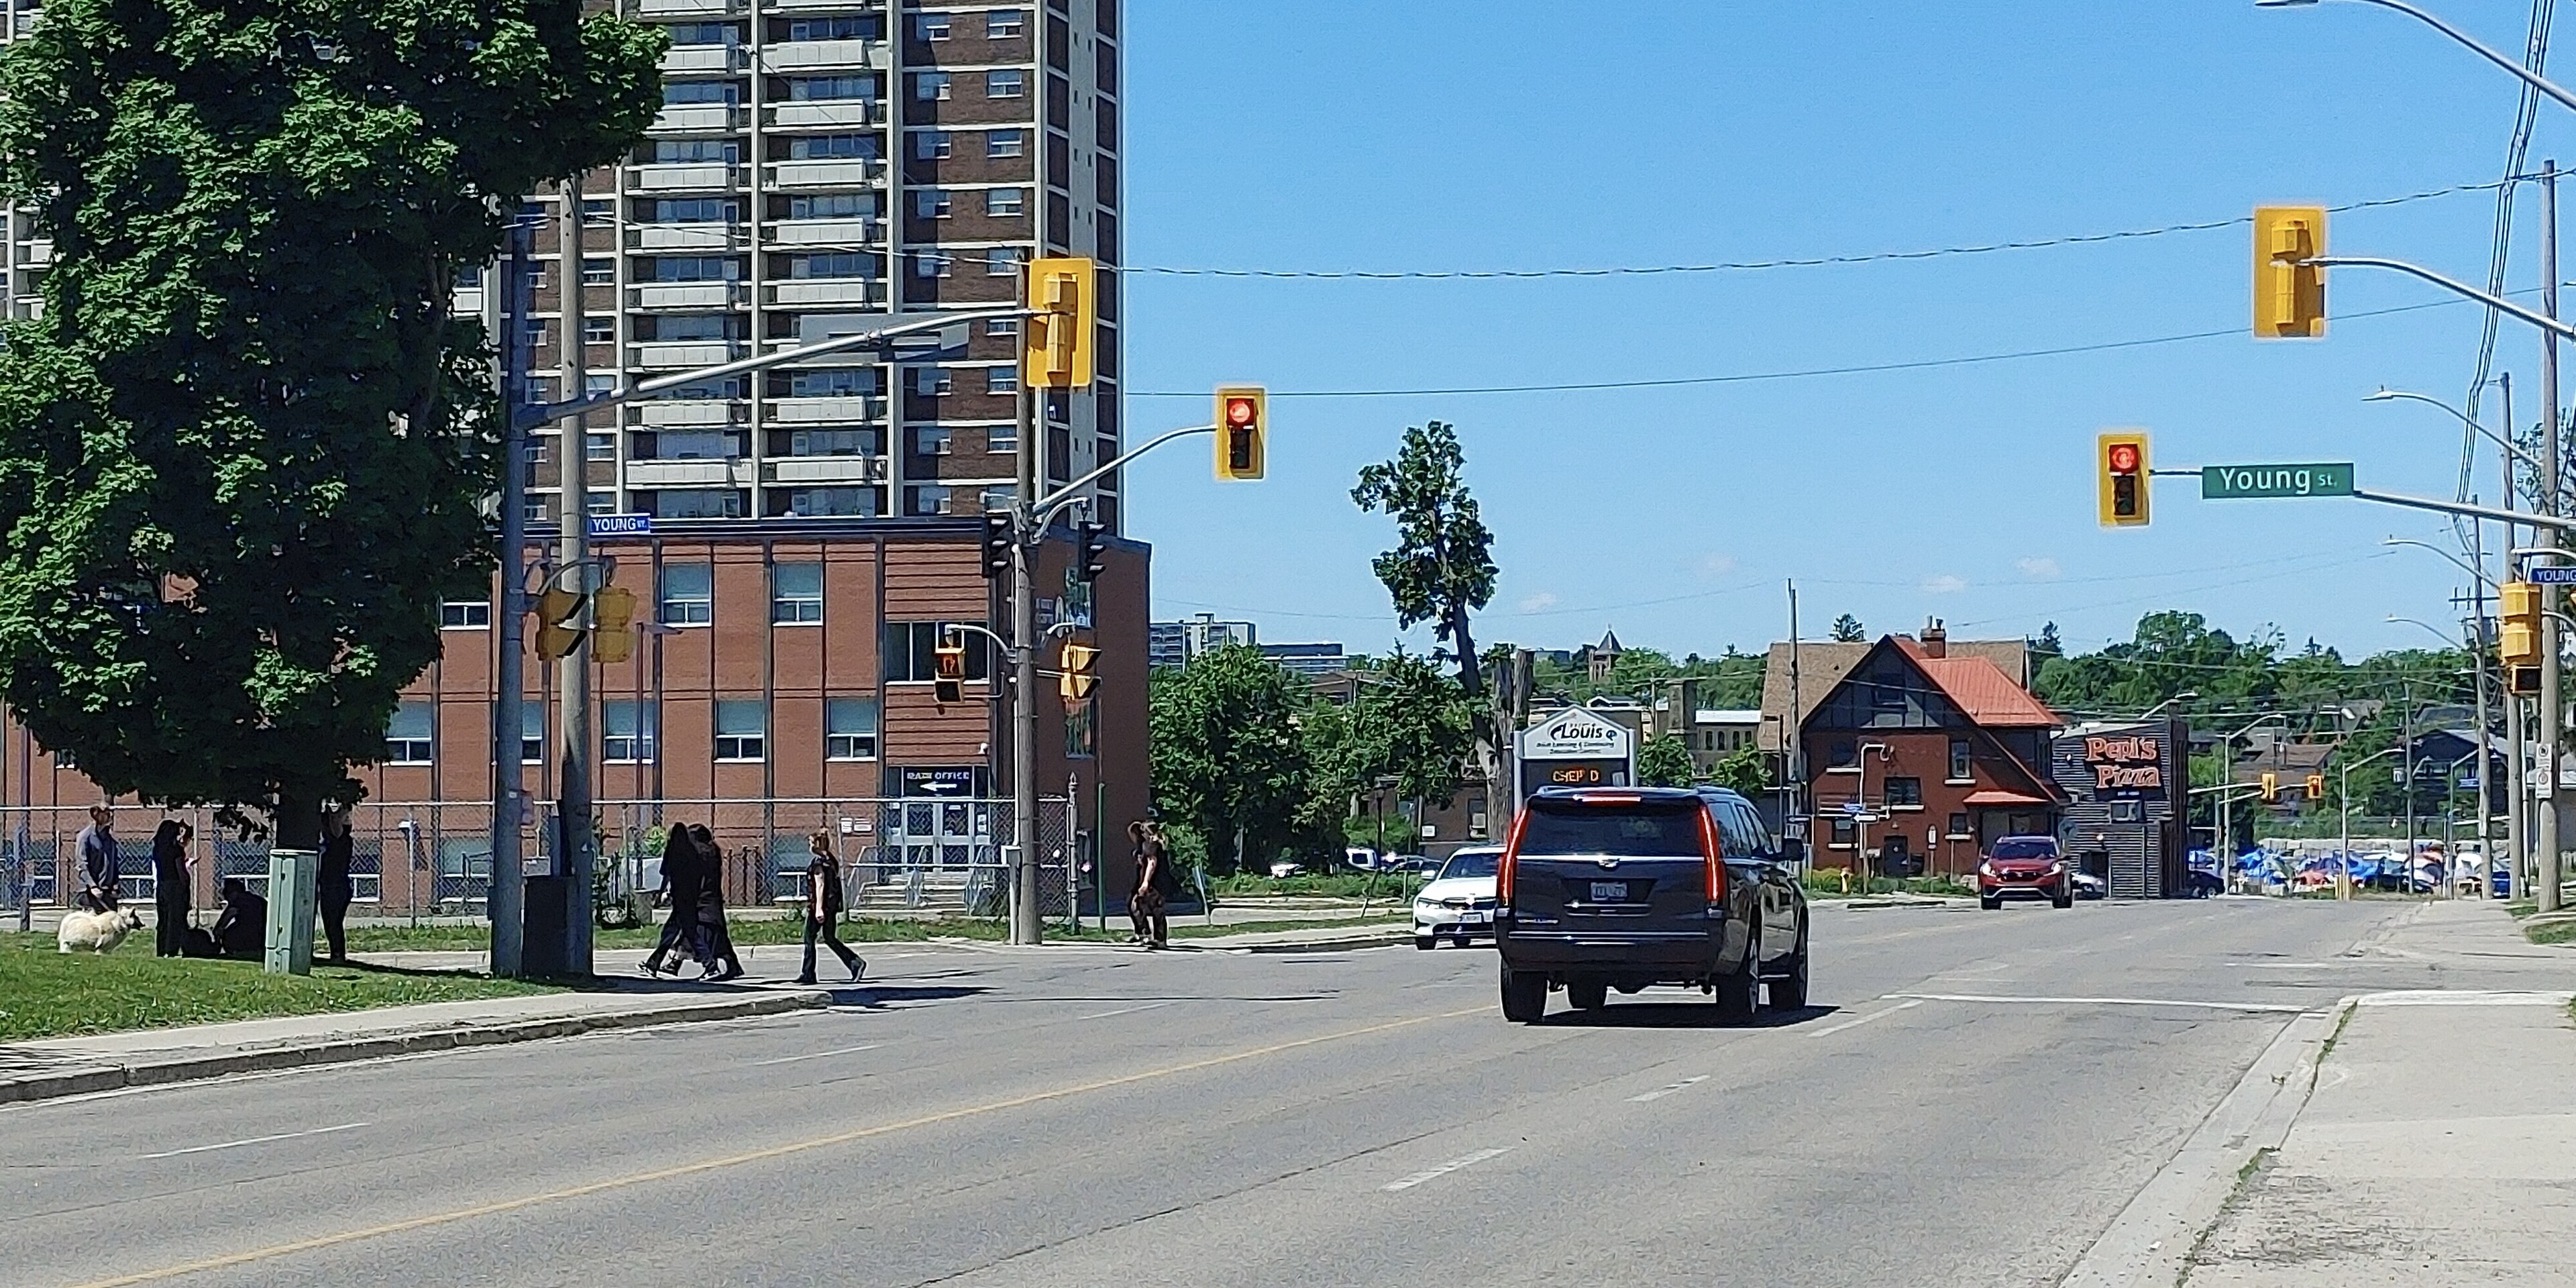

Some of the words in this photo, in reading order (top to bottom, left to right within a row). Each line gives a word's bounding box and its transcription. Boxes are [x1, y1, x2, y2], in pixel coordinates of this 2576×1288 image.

[2220, 468, 2310, 494] Young
[592, 518, 636, 531] YOUNG
[1560, 722, 1603, 739] Louis
[2085, 737, 2157, 762] Pepi's
[2094, 764, 2161, 788] Pizza
